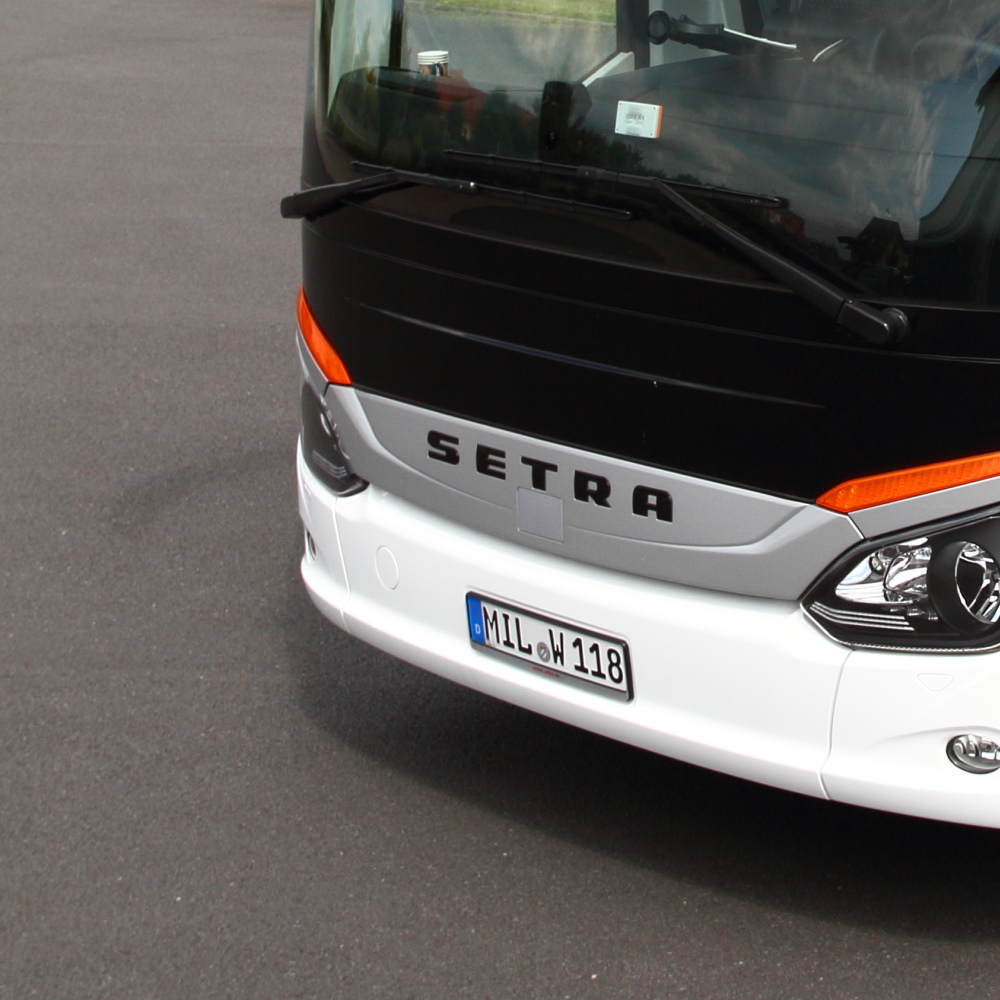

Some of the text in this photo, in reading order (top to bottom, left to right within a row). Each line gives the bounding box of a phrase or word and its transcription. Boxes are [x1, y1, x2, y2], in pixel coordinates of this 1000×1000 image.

[426, 429, 674, 523] SETRA
[475, 624, 481, 635] D
[482, 606, 533, 655] MIL
